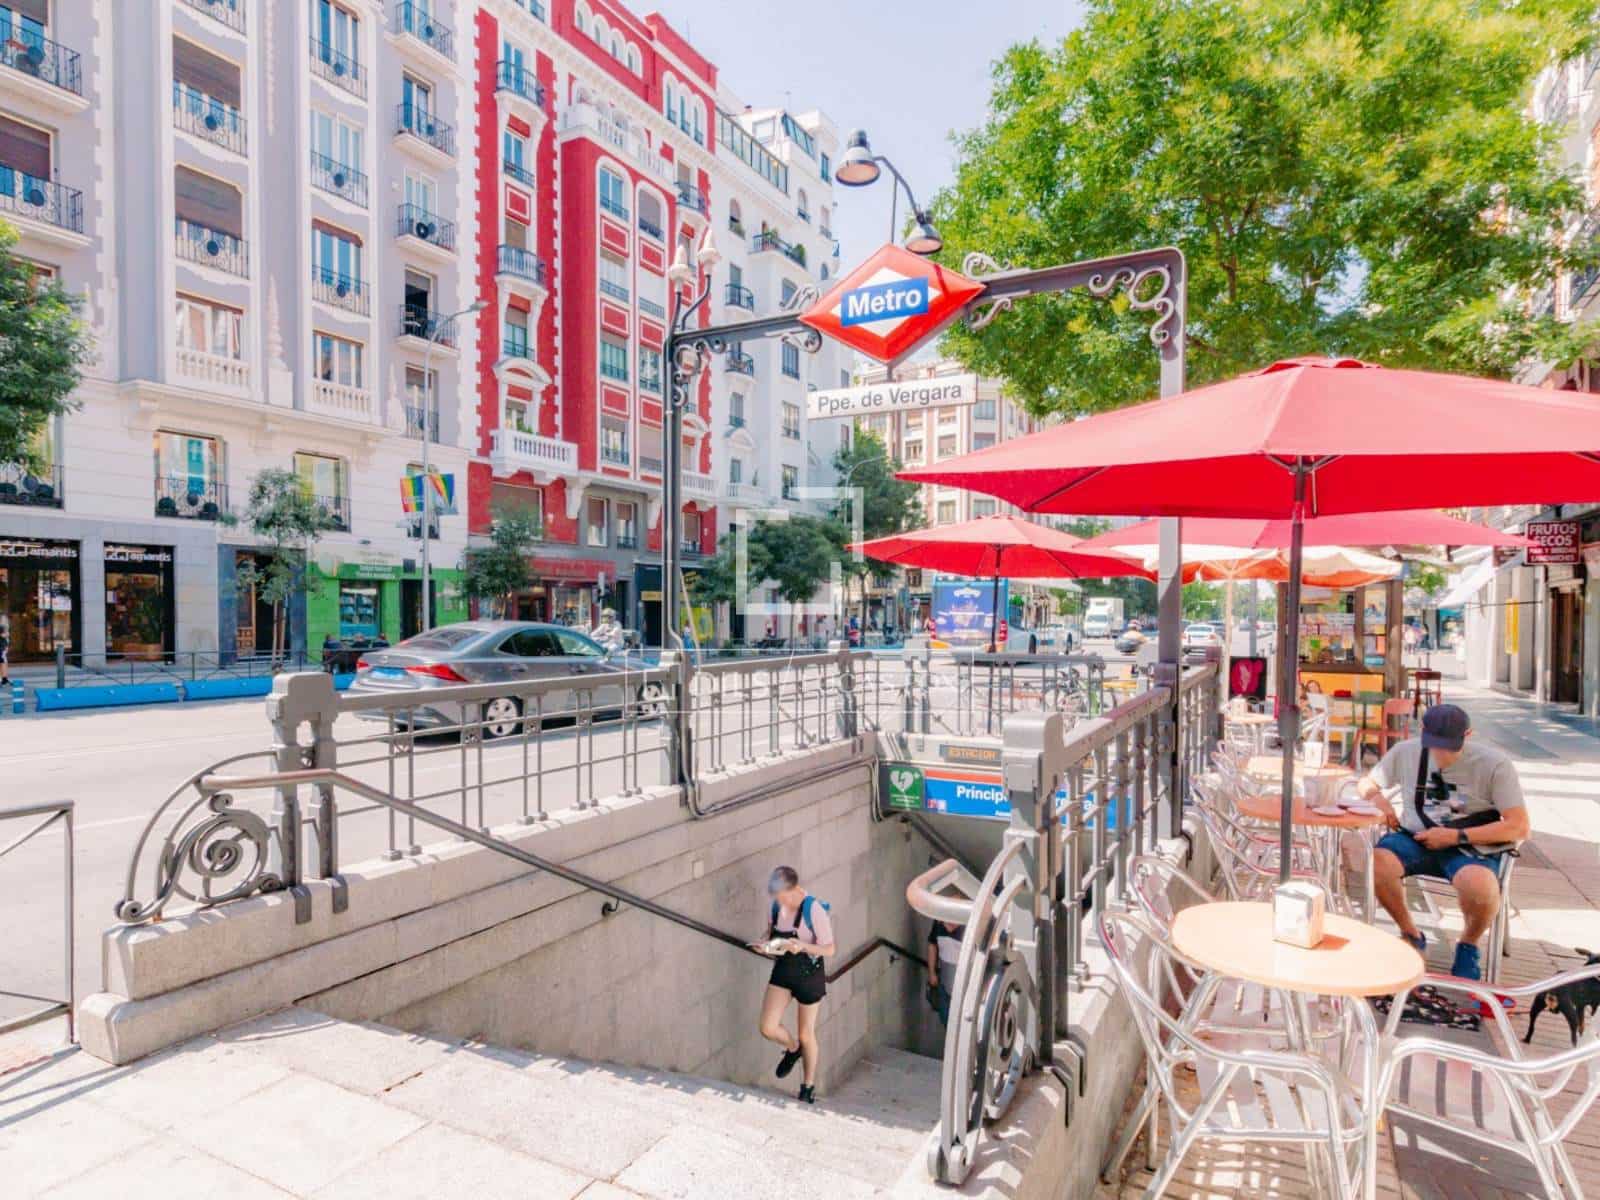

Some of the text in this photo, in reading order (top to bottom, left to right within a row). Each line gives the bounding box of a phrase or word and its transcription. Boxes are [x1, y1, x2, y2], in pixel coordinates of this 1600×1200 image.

[848, 289, 922, 318] Metro
[818, 384, 962, 413] Ppe. de Vergara
[1529, 523, 1577, 536] FRUTOS
